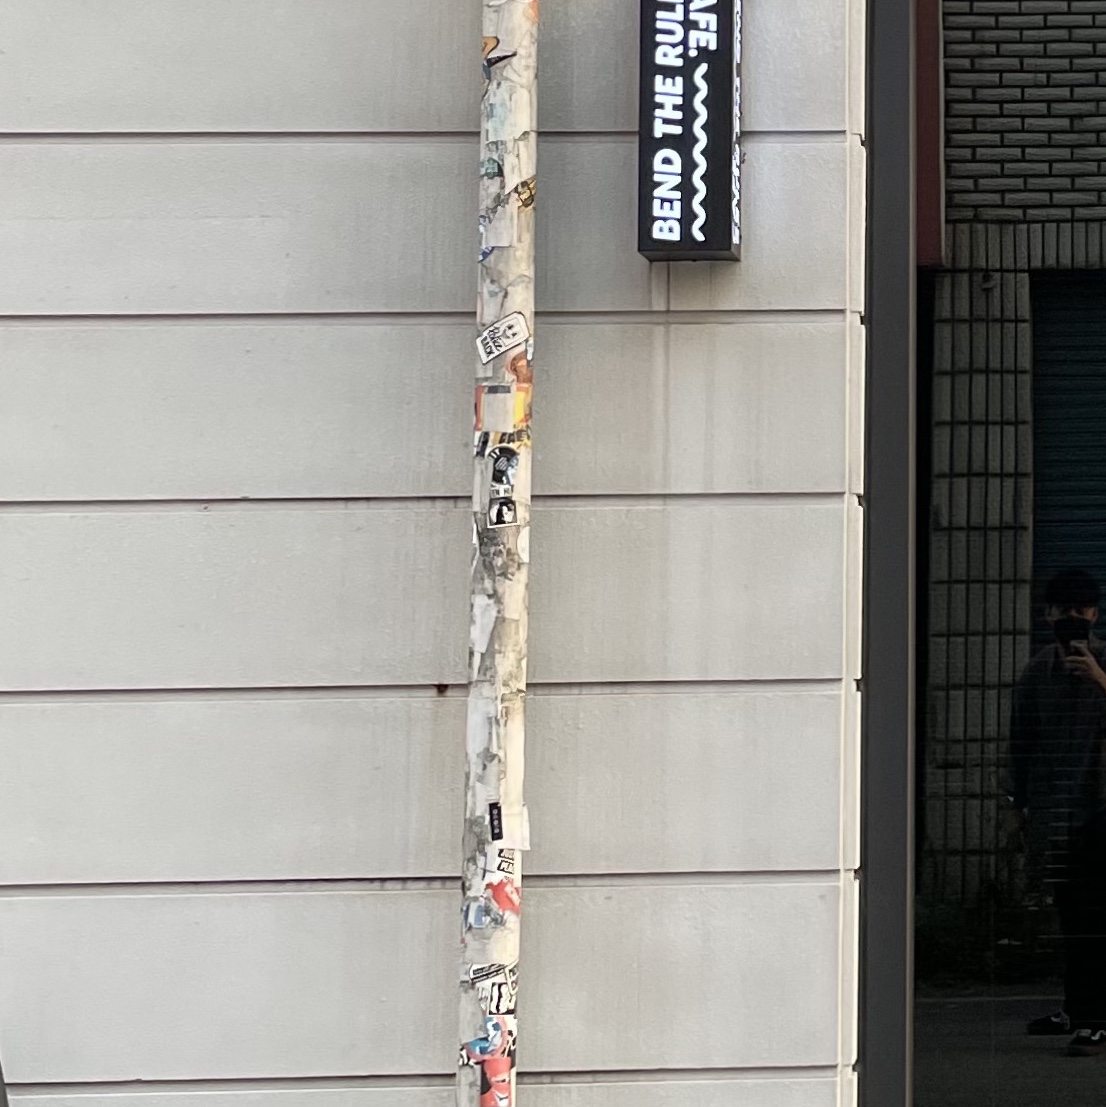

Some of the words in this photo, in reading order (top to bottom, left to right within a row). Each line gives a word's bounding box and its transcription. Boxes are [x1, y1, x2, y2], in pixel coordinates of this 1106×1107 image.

[654, 0, 684, 67] RUL
[654, 74, 684, 139] THE
[652, 148, 682, 241] BEND
